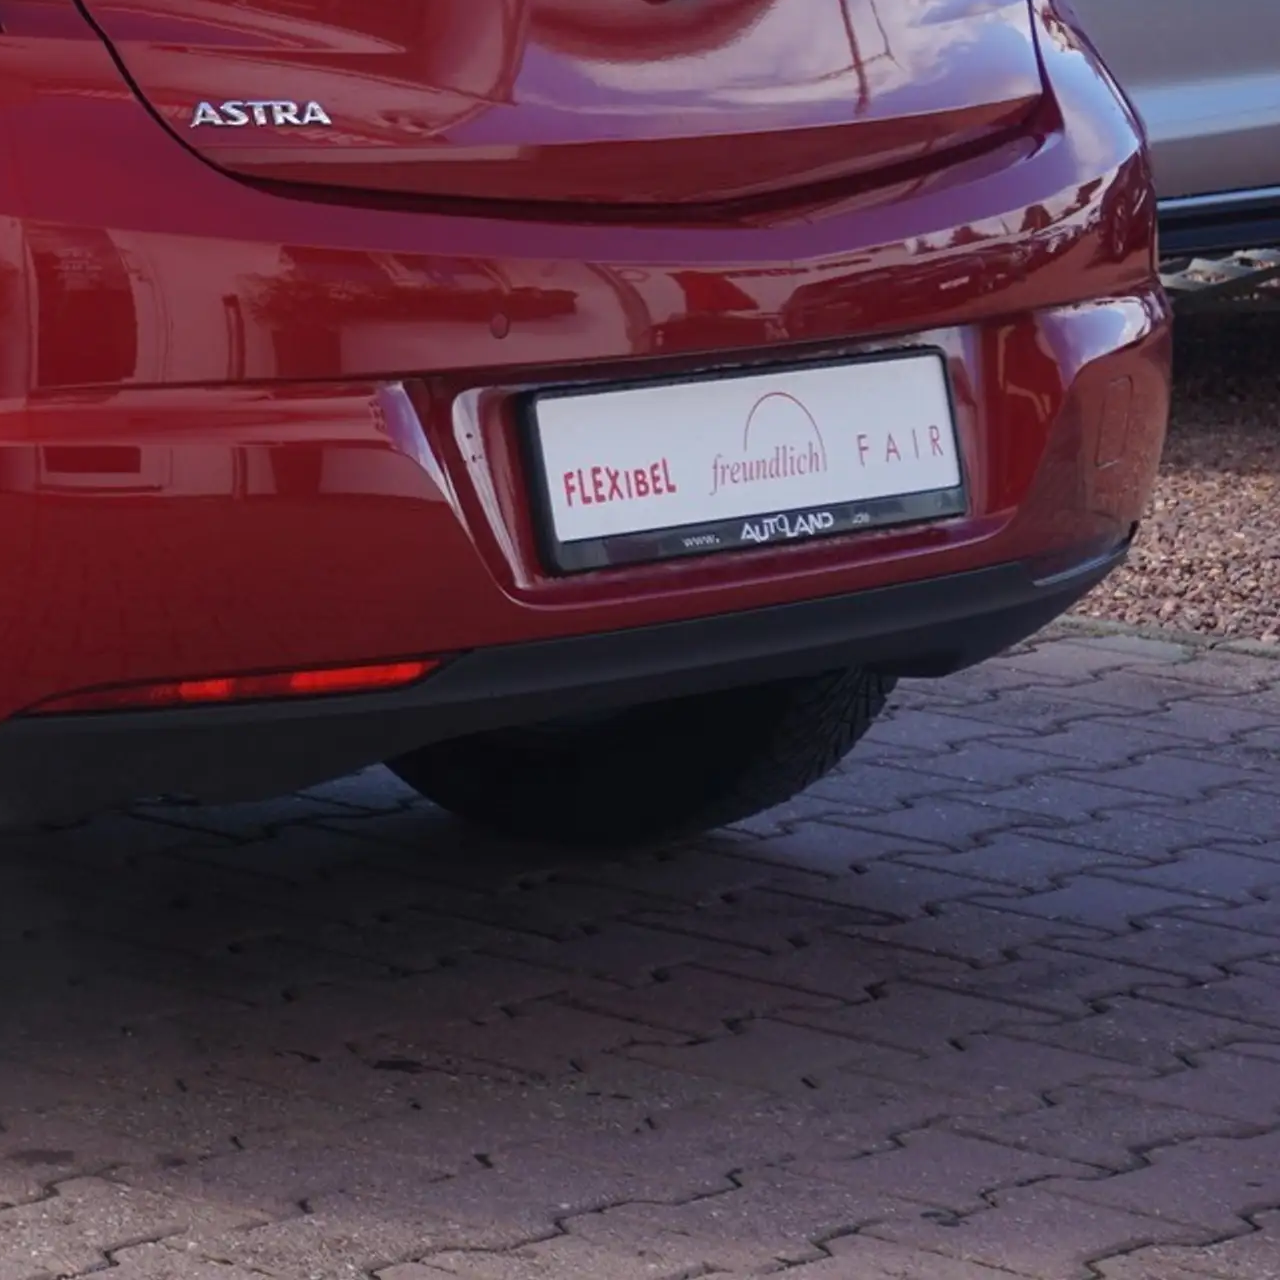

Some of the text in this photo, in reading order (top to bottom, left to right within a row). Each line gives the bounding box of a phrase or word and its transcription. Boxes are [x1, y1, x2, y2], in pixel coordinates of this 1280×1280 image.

[190, 100, 333, 128] ASTRA
[563, 424, 945, 508] FLEXIBEL freundlich FAIR
[740, 511, 834, 544] AUTOLAND
